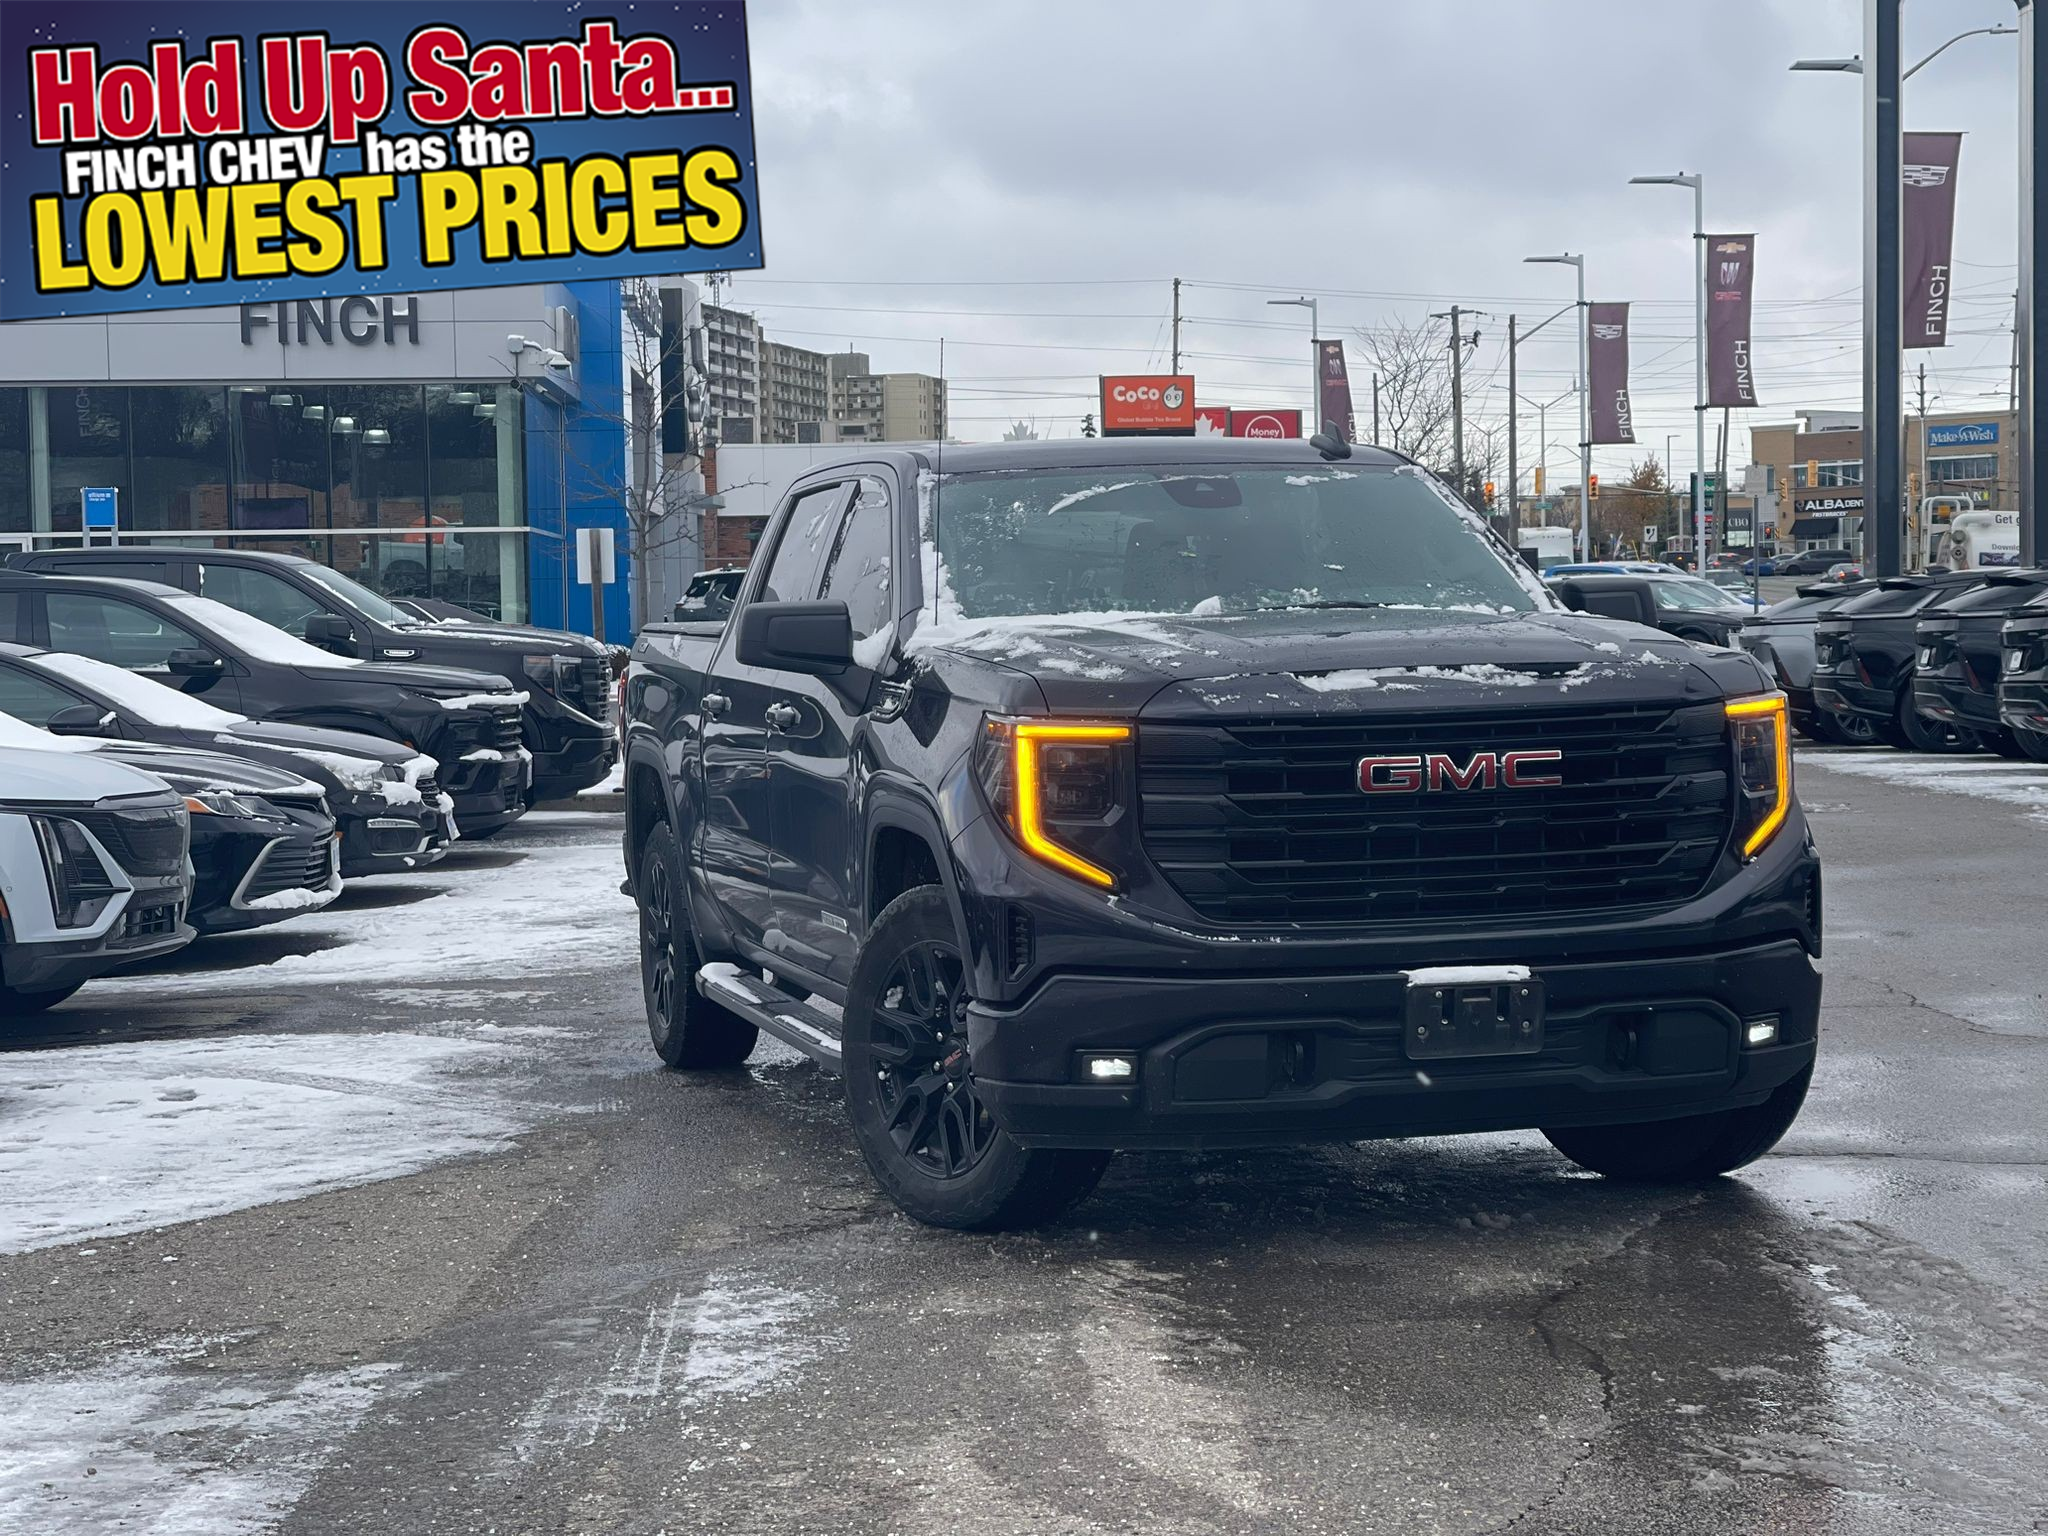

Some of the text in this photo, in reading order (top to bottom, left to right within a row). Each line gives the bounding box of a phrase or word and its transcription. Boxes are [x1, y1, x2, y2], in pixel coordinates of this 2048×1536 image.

[240, 296, 420, 346] FINCH
[1926, 265, 1948, 336] FINCH
[1735, 340, 1753, 400] FINCH
[1250, 428, 1280, 438] Money
[1616, 389, 1632, 439] FINCH
[1995, 514, 2013, 525] Get
[1356, 749, 1563, 794] GMC
